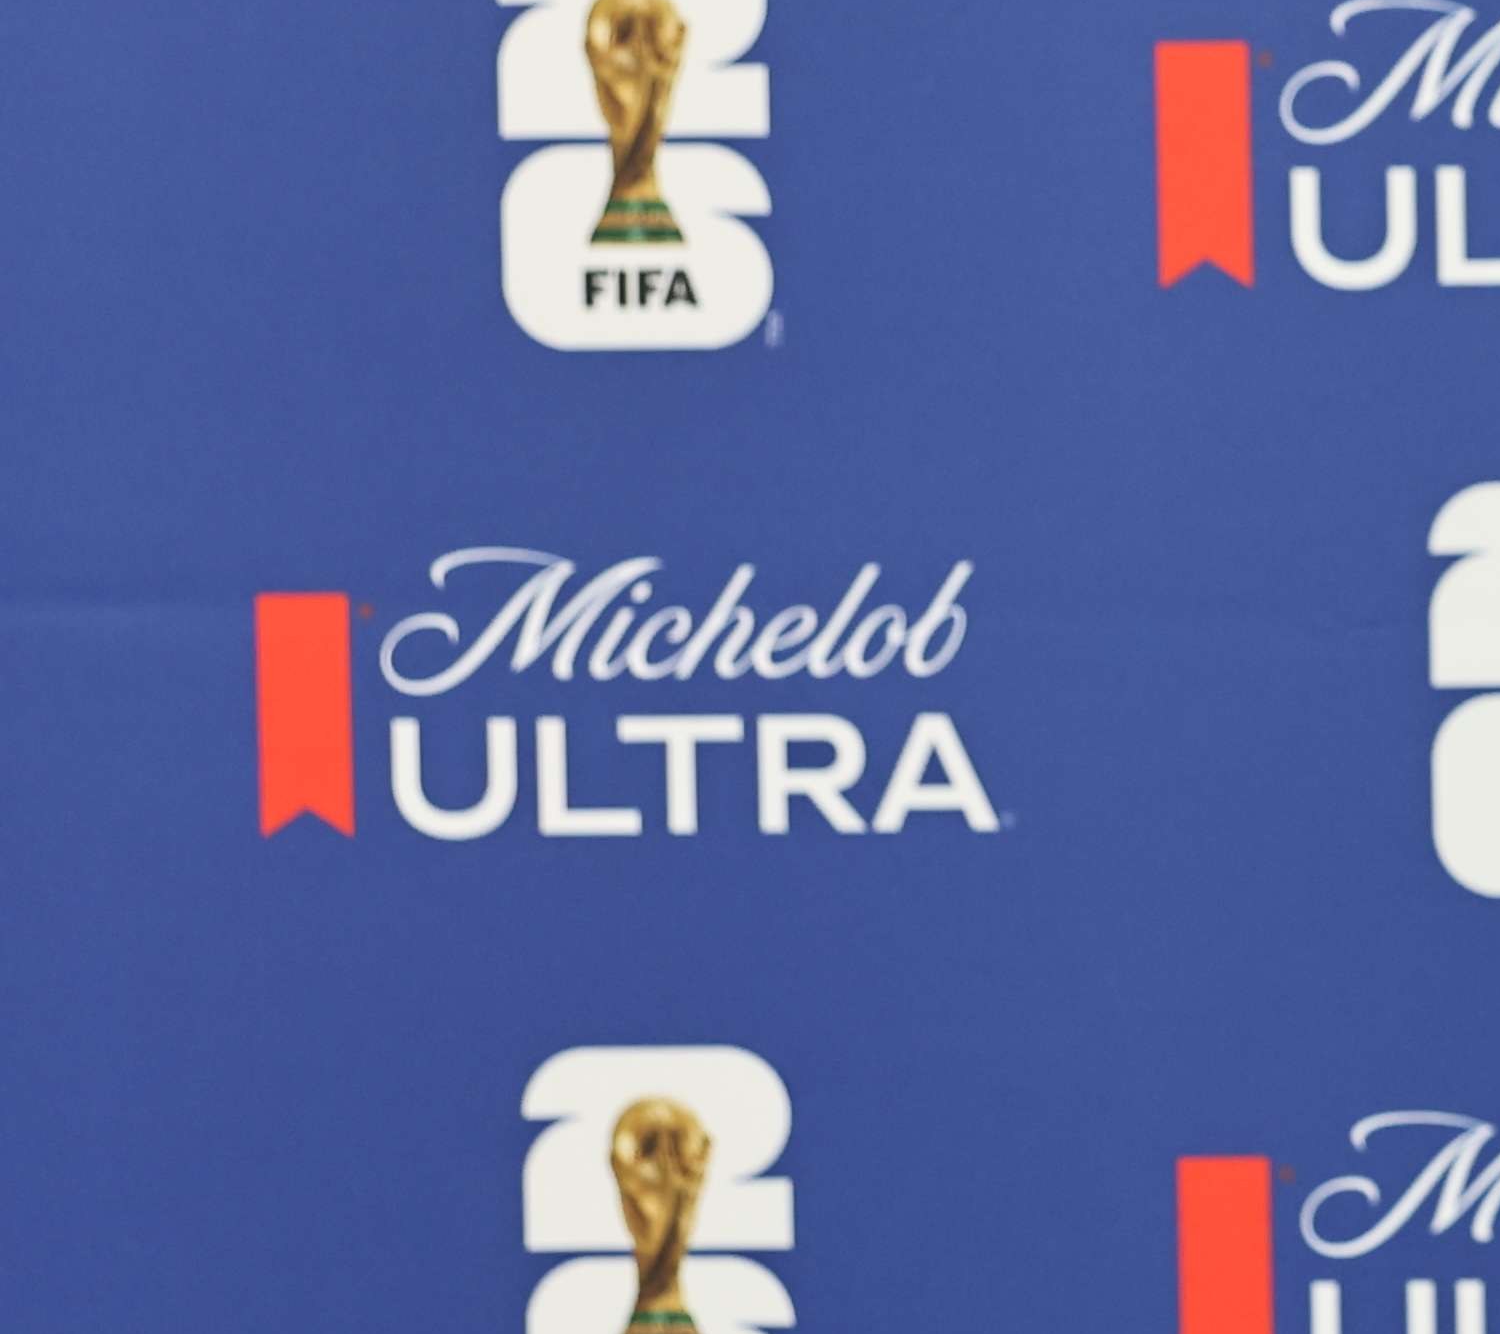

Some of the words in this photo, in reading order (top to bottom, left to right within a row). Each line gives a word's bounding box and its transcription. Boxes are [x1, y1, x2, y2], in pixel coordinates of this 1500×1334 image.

[582, 267, 700, 309] FIFA
[377, 545, 975, 698] Michelob
[388, 710, 1001, 843] ULTRA
